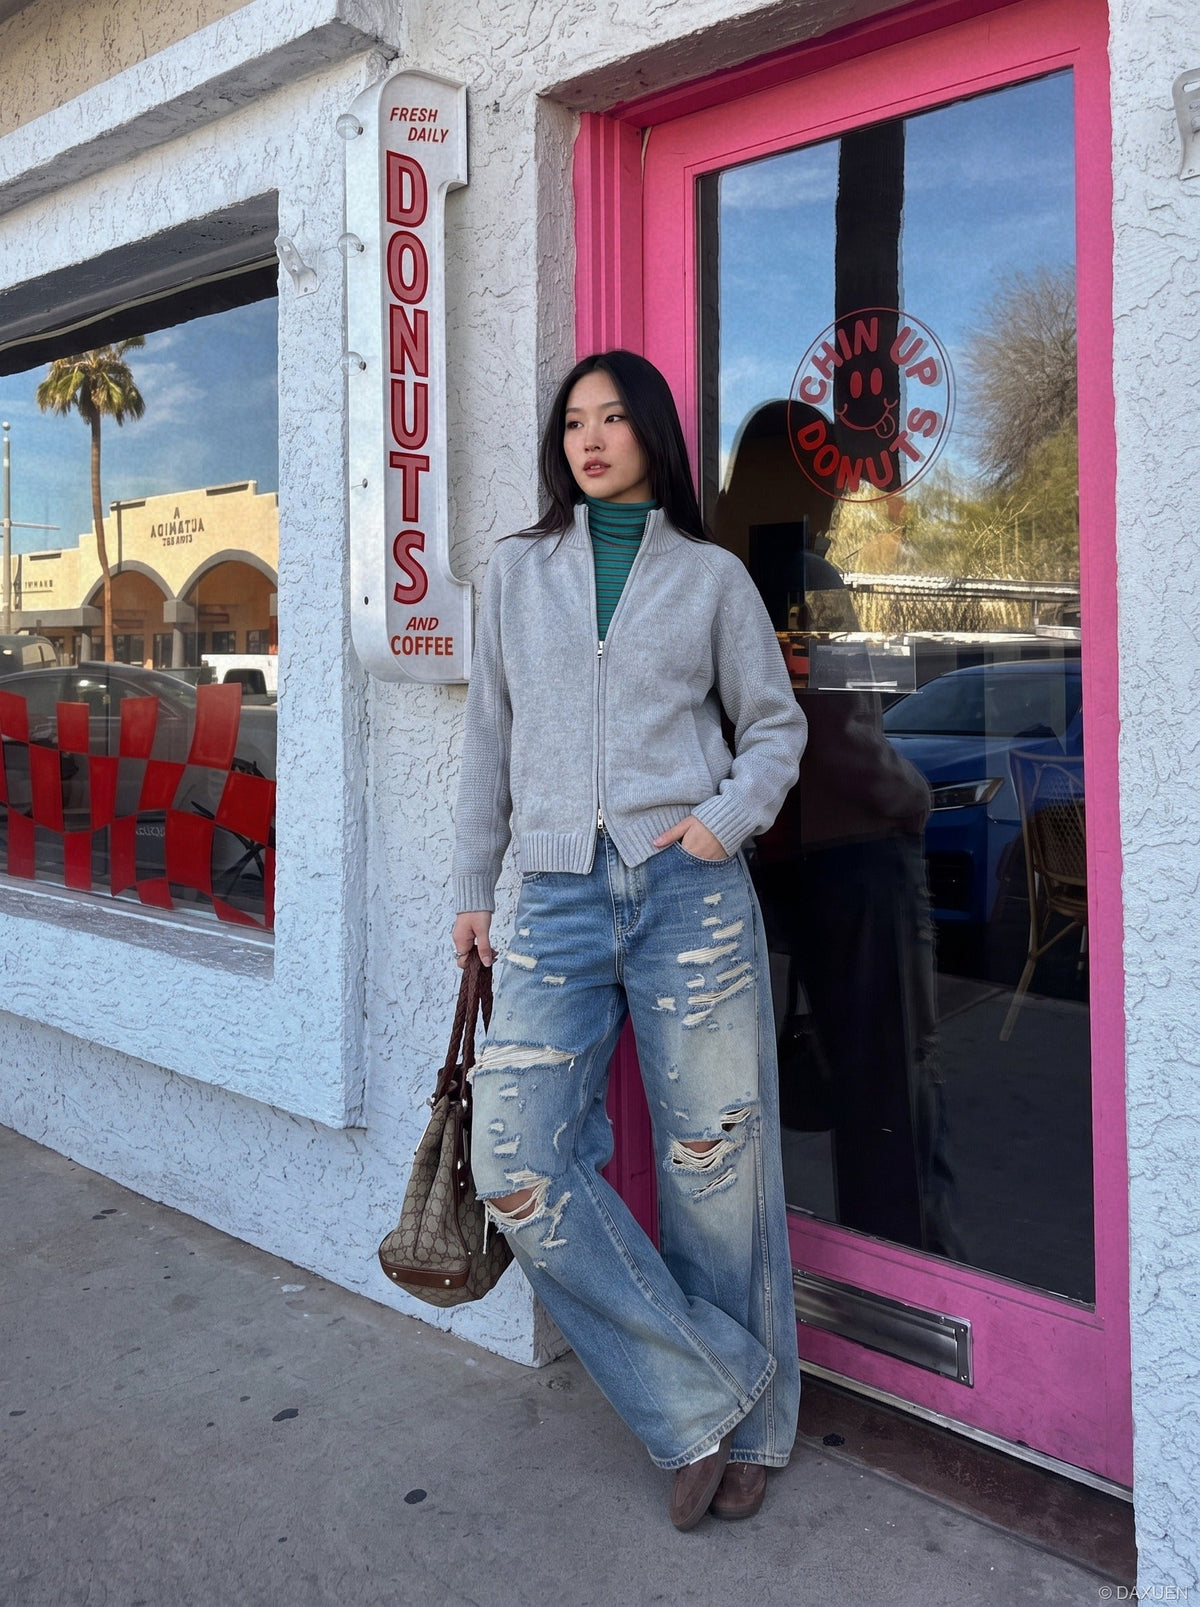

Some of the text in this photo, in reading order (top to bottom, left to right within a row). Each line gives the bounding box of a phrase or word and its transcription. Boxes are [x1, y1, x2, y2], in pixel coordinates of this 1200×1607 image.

[389, 107, 438, 123] FRESH
[407, 126, 449, 143] DAILY
[799, 316, 938, 405] CHIN UP
[386, 150, 430, 605] DONUTS
[797, 407, 938, 492] DONUTS
[405, 616, 439, 631] AND
[390, 635, 454, 656] COFFEE
